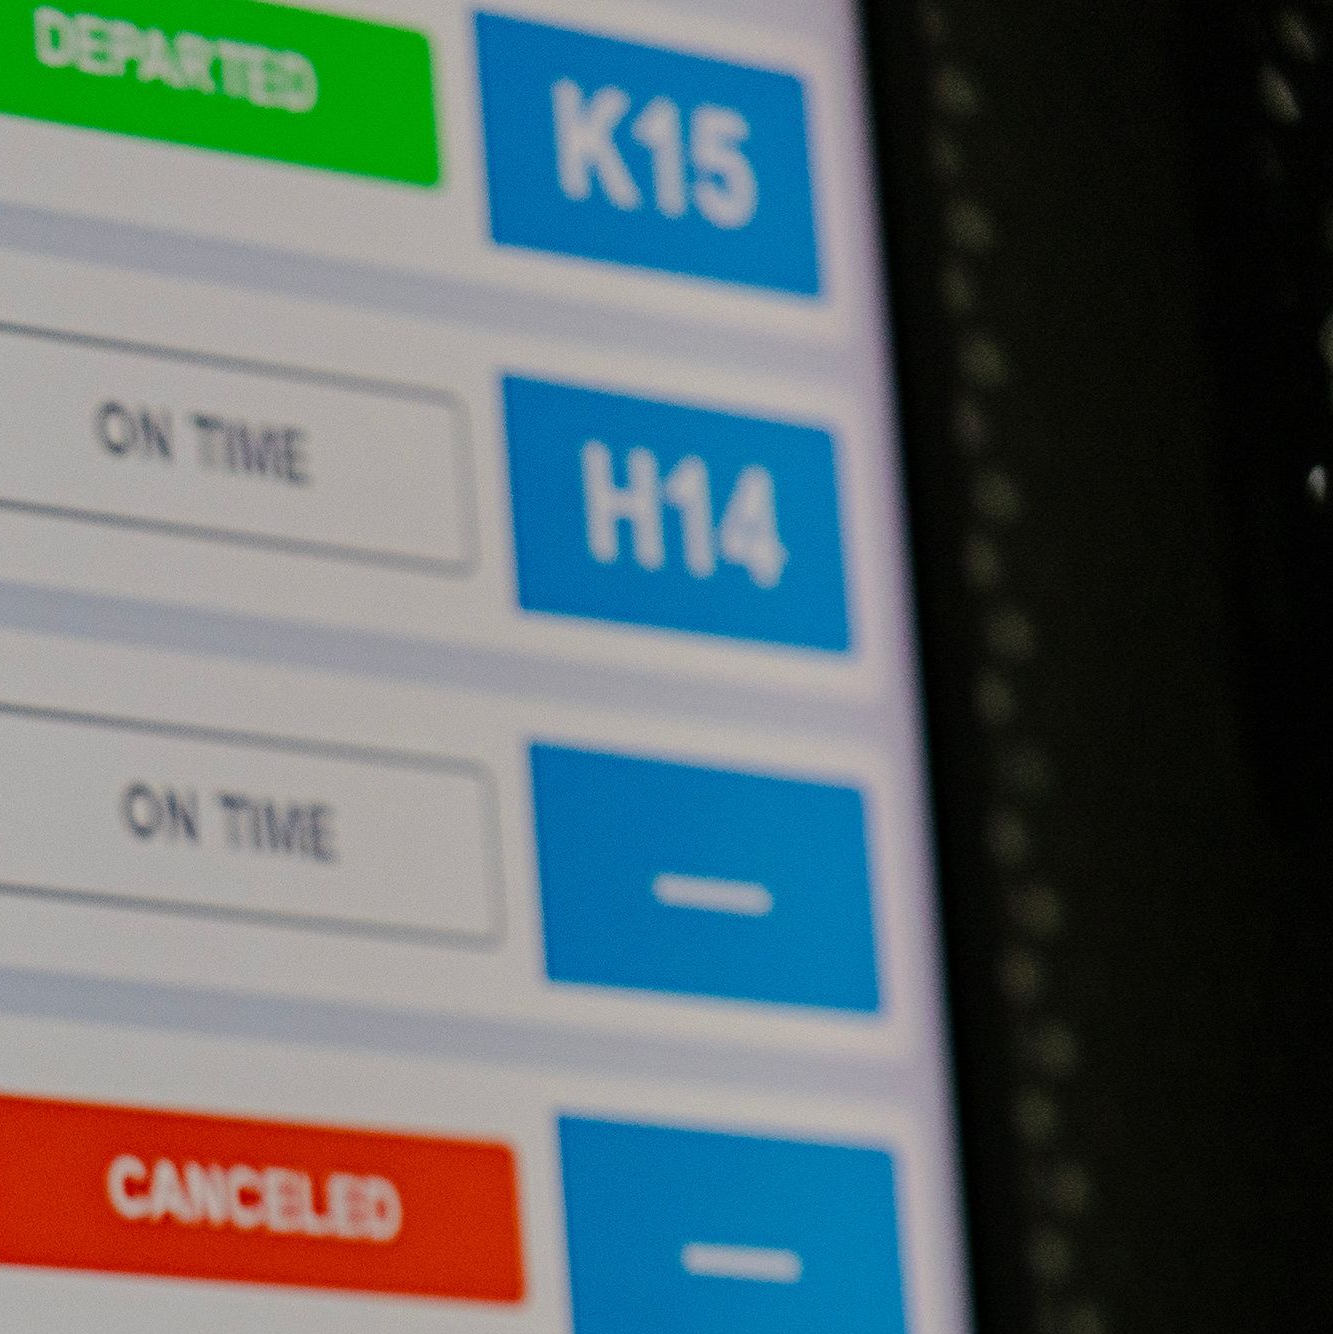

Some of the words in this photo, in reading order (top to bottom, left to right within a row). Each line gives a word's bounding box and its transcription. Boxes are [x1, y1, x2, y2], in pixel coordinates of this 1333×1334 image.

[33, 5, 319, 113] DEPARTED
[550, 76, 760, 231] K15
[96, 400, 176, 462] ON
[190, 412, 308, 487] TIME
[582, 442, 786, 586] H14
[122, 782, 200, 842] ON
[217, 791, 335, 863] TIME
[106, 1155, 403, 1242] CANCELED
